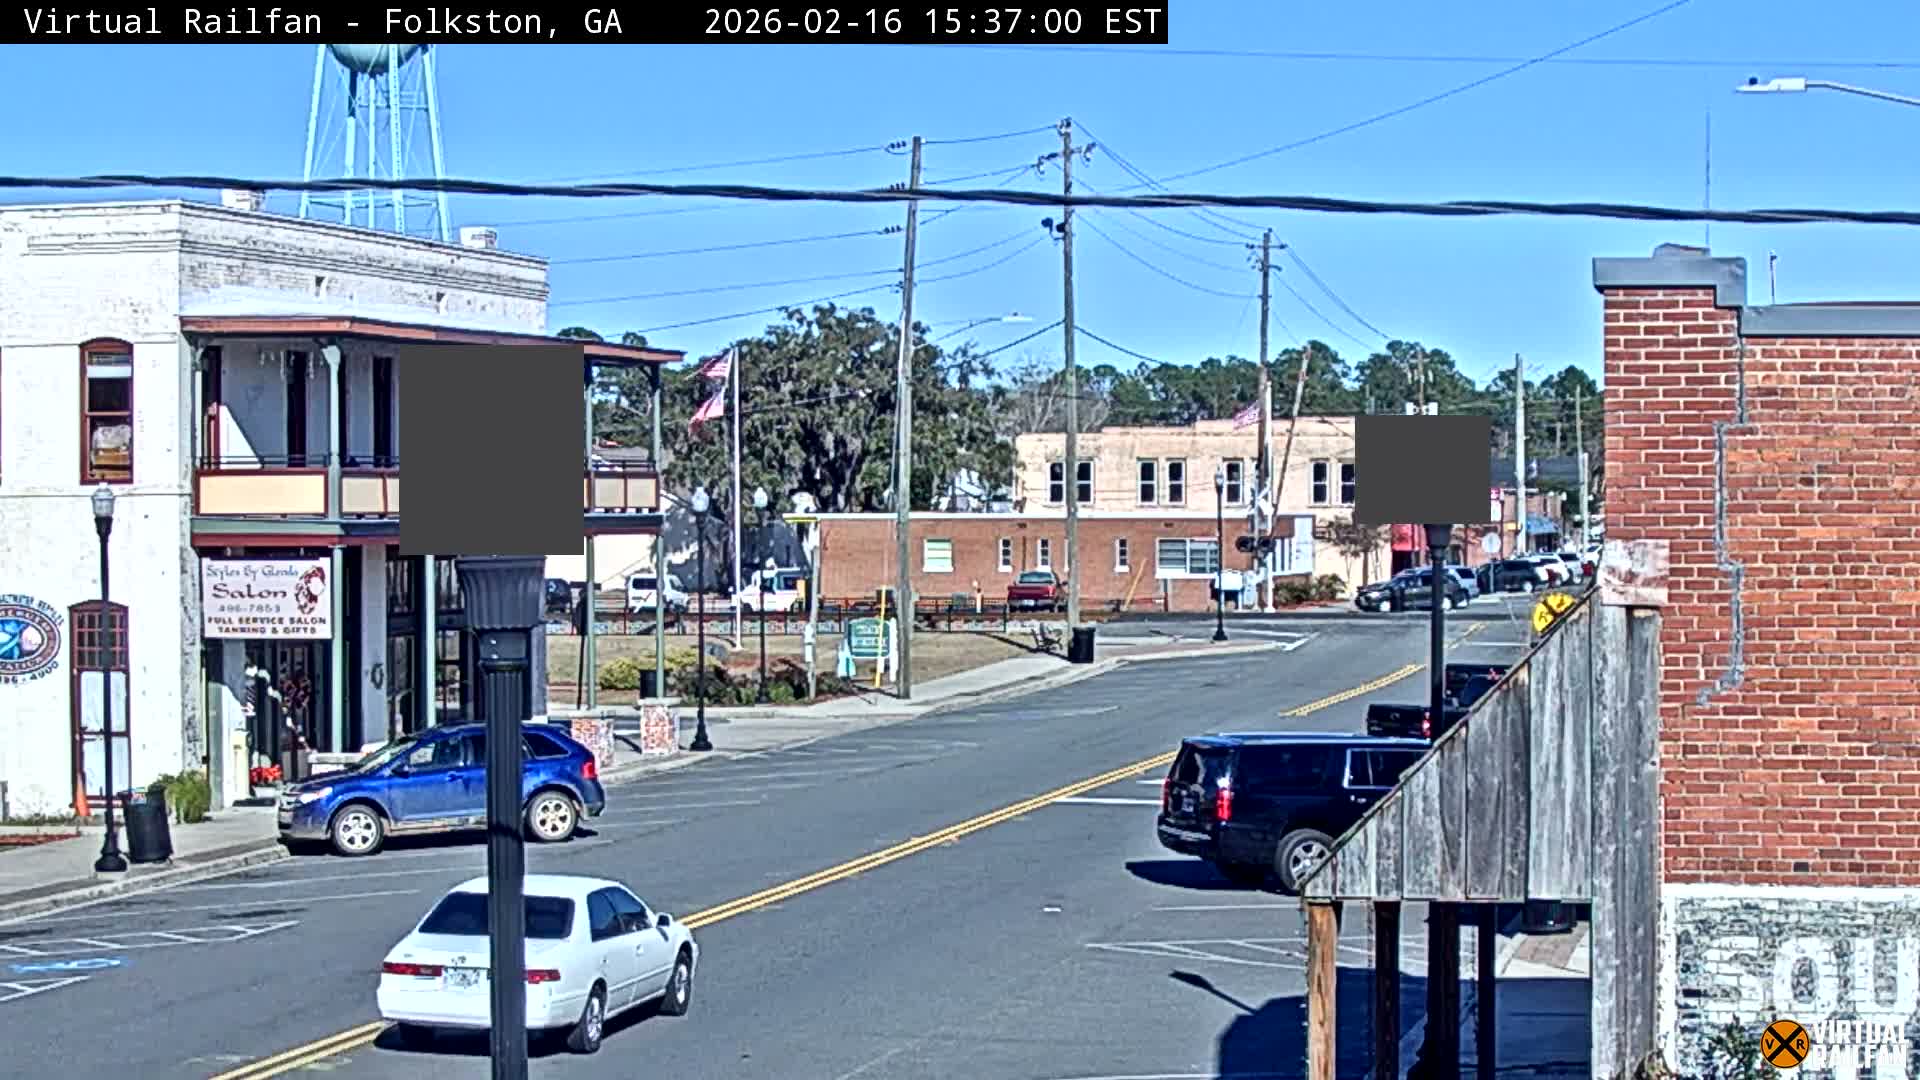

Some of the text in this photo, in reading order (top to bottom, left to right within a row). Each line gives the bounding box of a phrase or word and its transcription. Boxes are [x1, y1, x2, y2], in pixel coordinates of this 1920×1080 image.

[212, 583, 288, 599] Salon
[207, 616, 327, 625] FULL SERVICE SALON
[217, 626, 267, 634] TANNING
[282, 626, 317, 634] GIFTS
